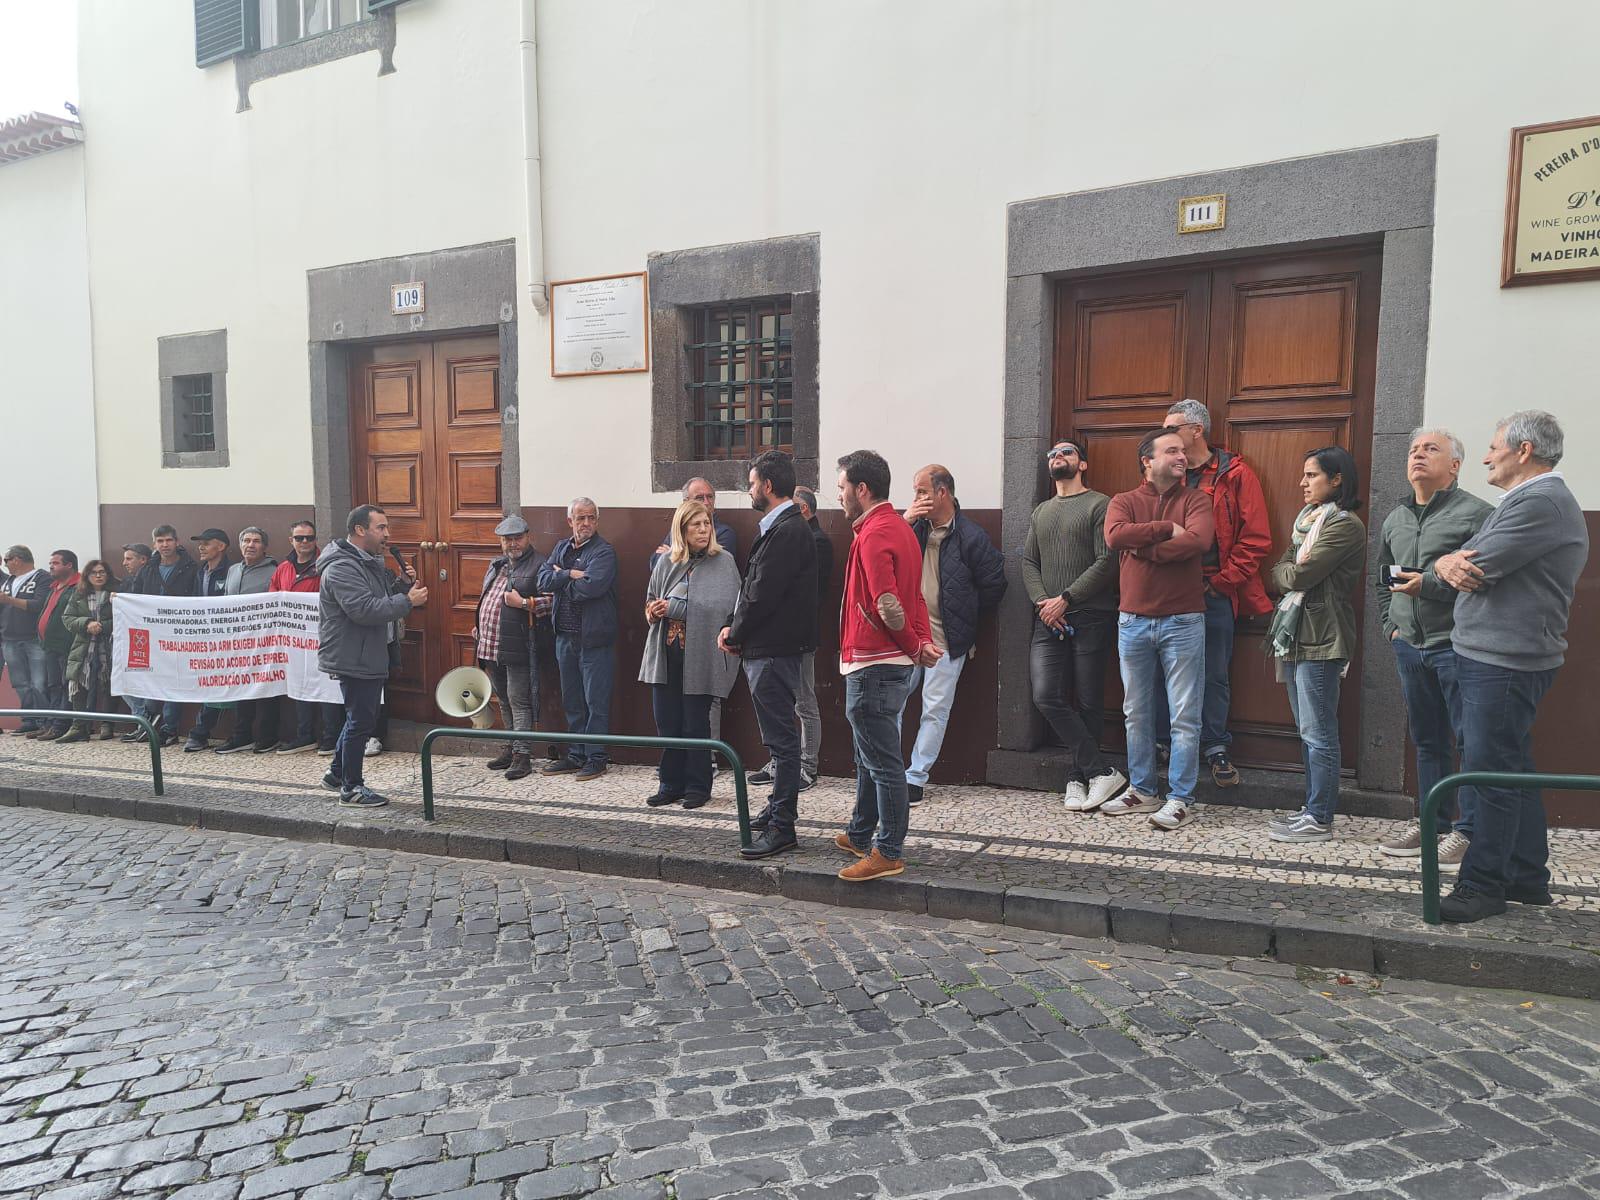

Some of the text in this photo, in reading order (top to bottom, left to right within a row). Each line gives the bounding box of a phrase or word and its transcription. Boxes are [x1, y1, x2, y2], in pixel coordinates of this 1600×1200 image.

[1534, 148, 1579, 182] PEREIRA
[1190, 206, 1210, 221] 111
[1531, 218, 1561, 229] WINE
[1531, 247, 1599, 262] MADEIRA
[397, 290, 418, 307] 109
[157, 608, 191, 616] SINDICATO
[207, 603, 264, 615] TRABALHADORES
[266, 601, 279, 609] DAS
[210, 617, 240, 625] ENERGIA
[247, 611, 291, 622] ACTIVIDADES
[159, 640, 208, 652] TRABALHADORES
[209, 641, 218, 652] DA
[219, 640, 231, 652] ARM
[233, 638, 256, 650] EXIGEM
[257, 634, 291, 648] AUMENTOS
[217, 658, 225, 668] DO
[226, 656, 251, 668] ACORDO
[252, 654, 262, 665] DE
[241, 674, 251, 685] DO
[251, 670, 286, 683] TRABALHO
